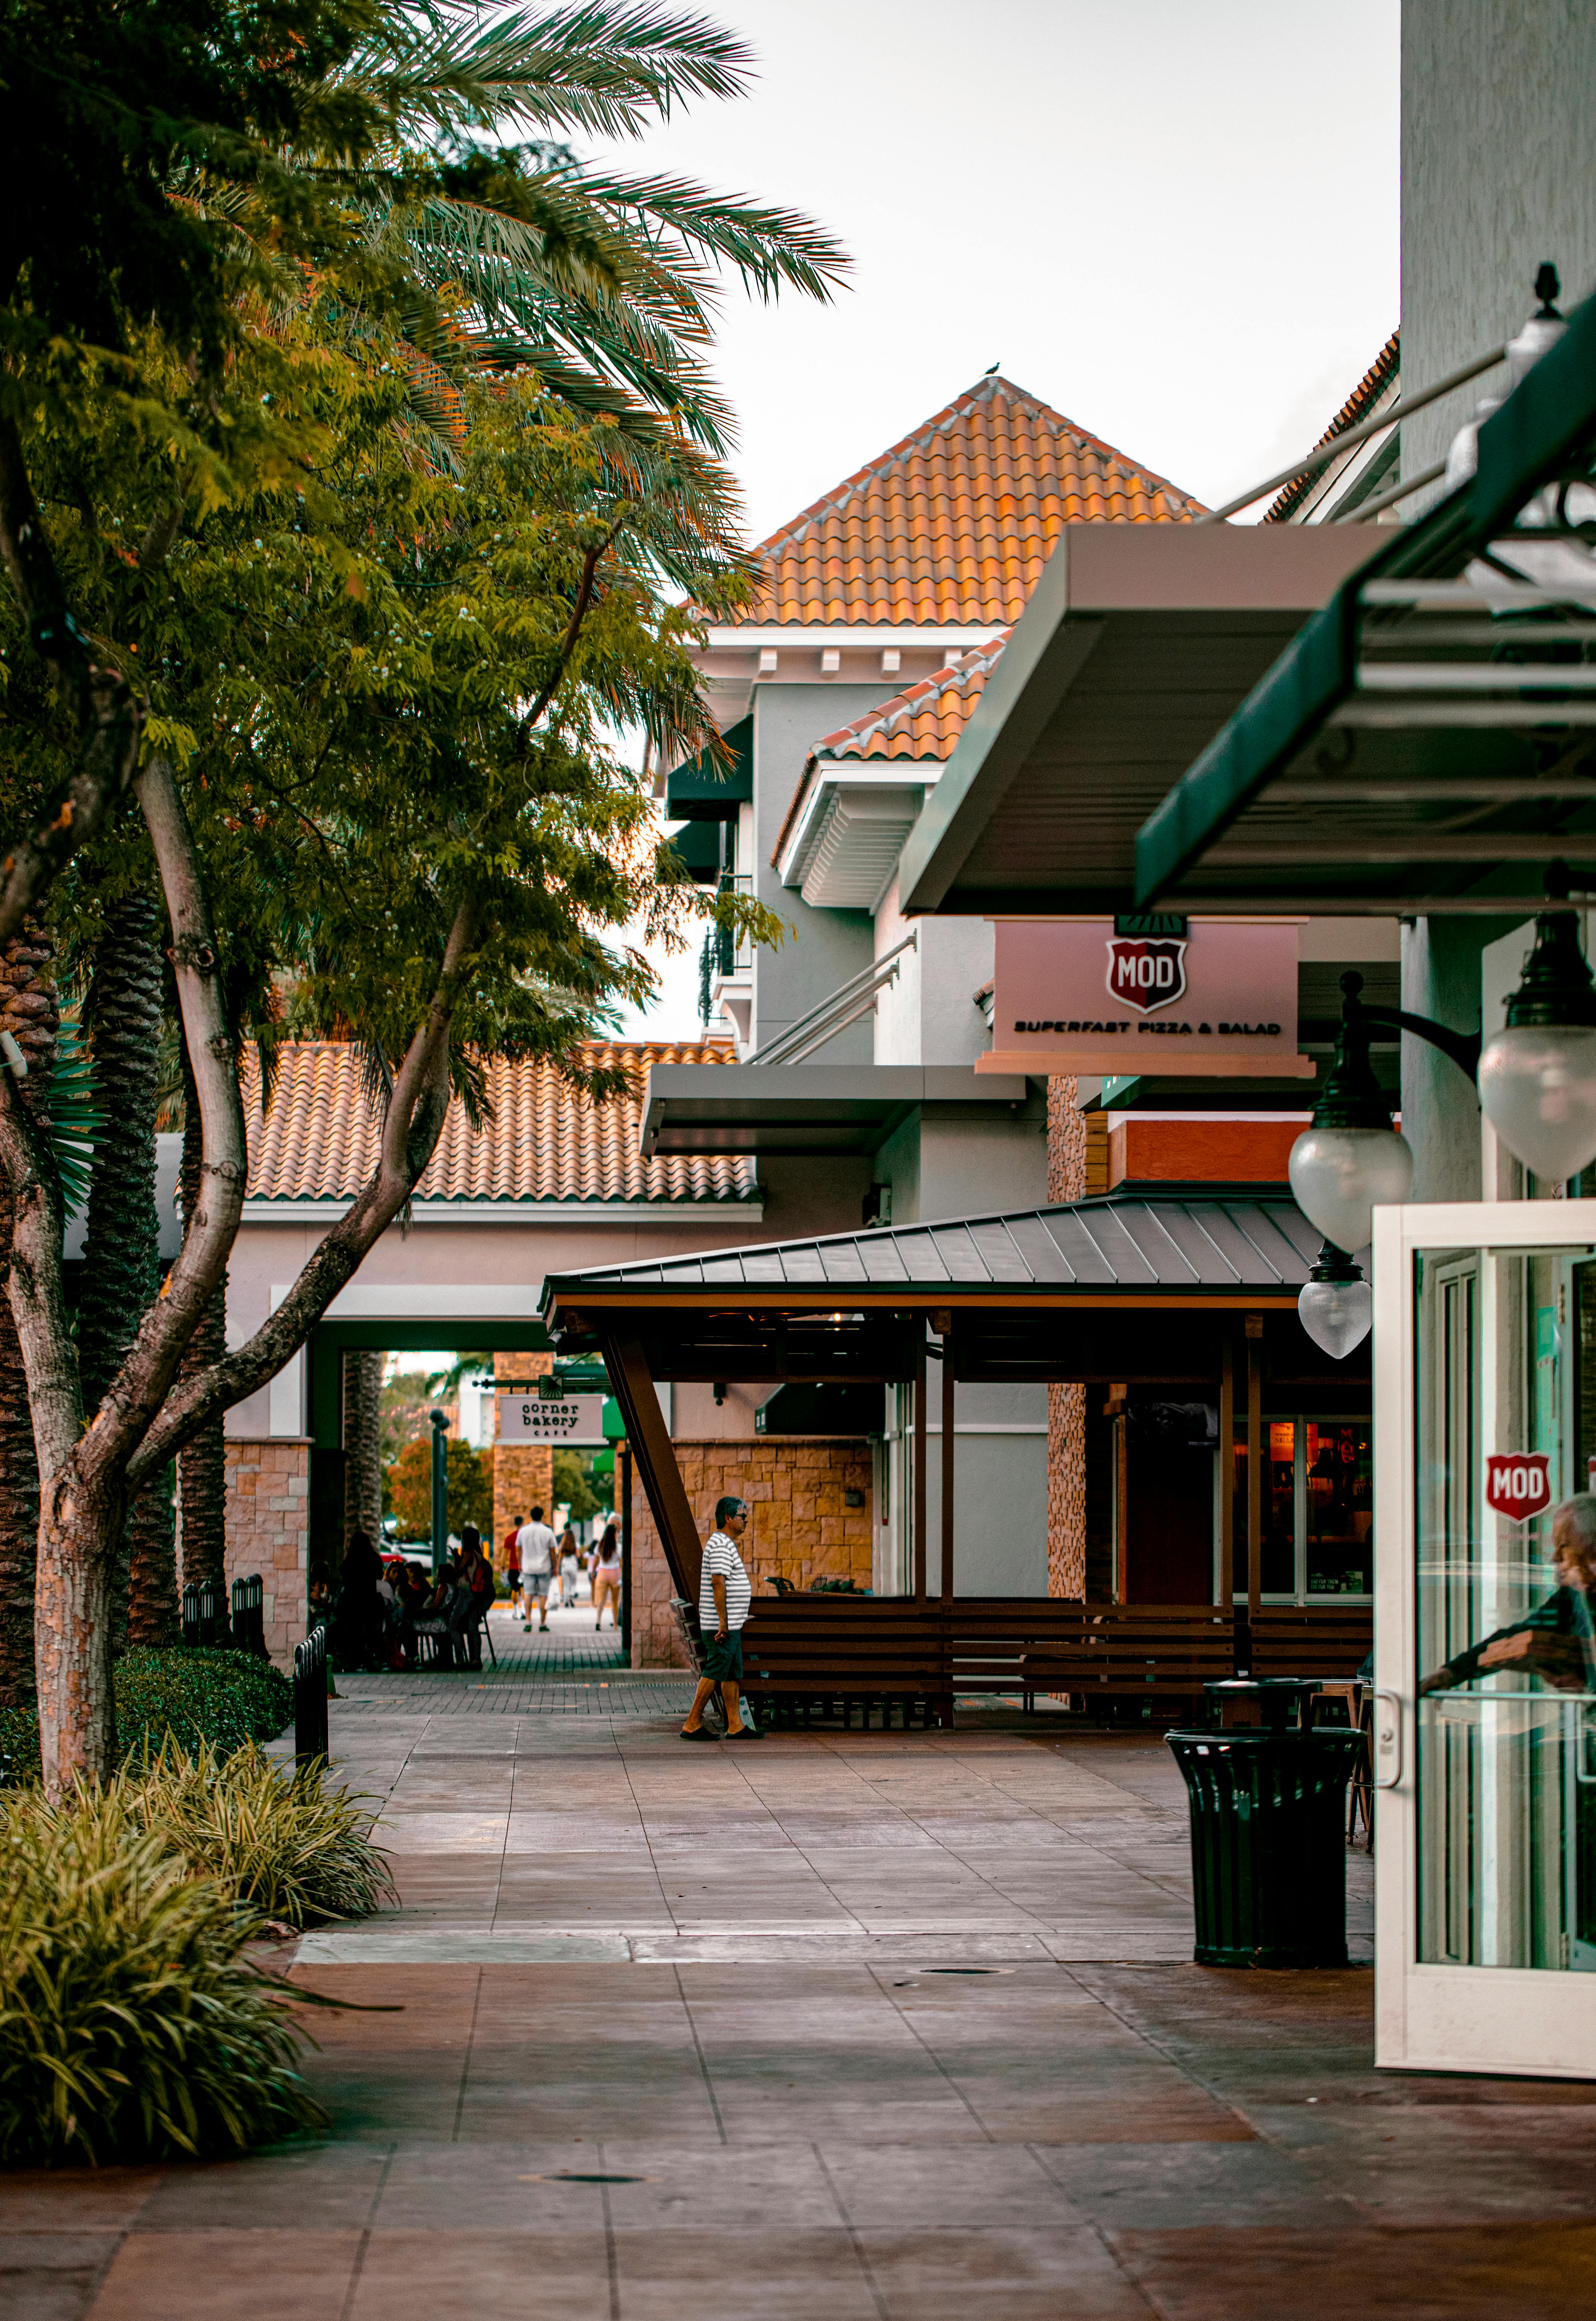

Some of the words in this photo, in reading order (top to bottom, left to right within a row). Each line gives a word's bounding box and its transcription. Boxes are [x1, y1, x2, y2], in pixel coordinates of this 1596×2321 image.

[1118, 956, 1174, 988] MOD
[1014, 1021, 1130, 1033] SUPERFAST
[1138, 1022, 1192, 1034] PIZZA
[1198, 1022, 1211, 1034] &
[1218, 1023, 1281, 1035] SALAD
[523, 1404, 578, 1413] corner
[523, 1415, 578, 1427] bakery
[1493, 1467, 1543, 1499] MOD
